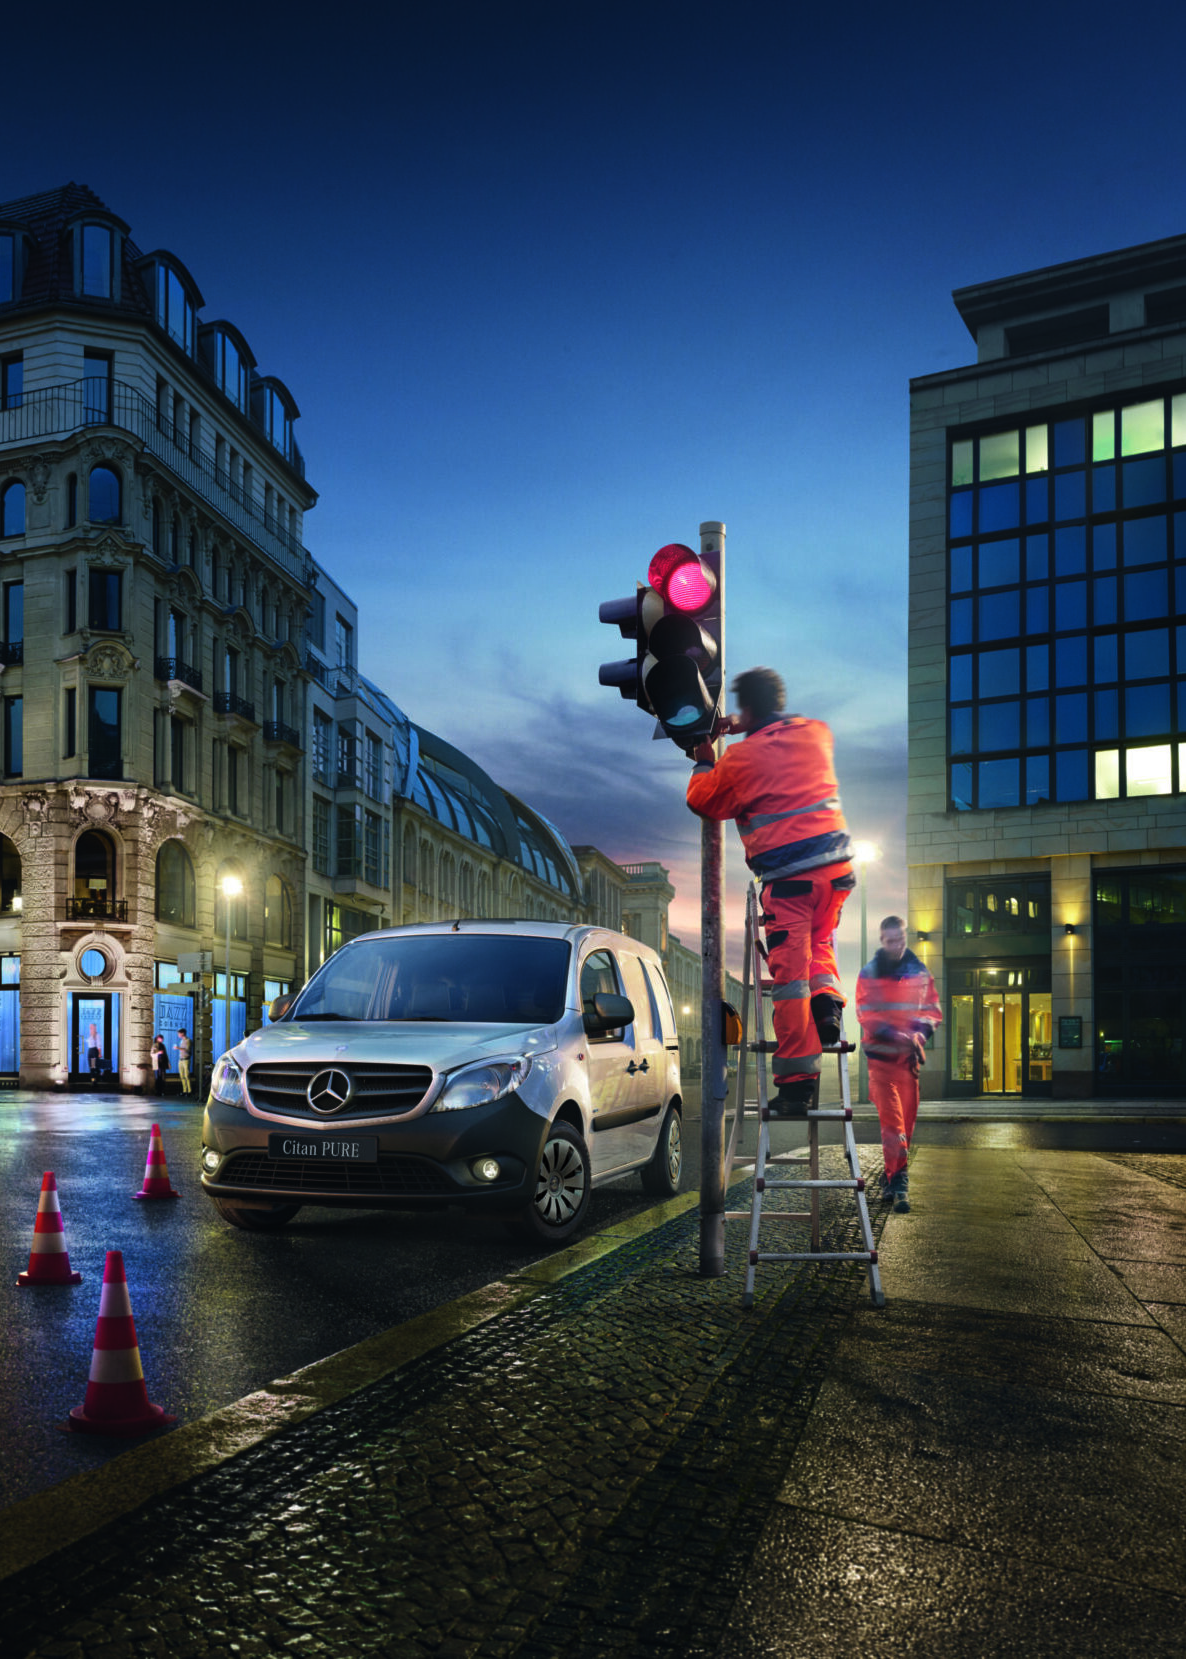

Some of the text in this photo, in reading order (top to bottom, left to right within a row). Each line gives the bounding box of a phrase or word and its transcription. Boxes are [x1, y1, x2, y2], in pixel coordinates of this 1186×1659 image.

[159, 1005, 187, 1021] JAZZ
[283, 1140, 359, 1157] Citan PURE
